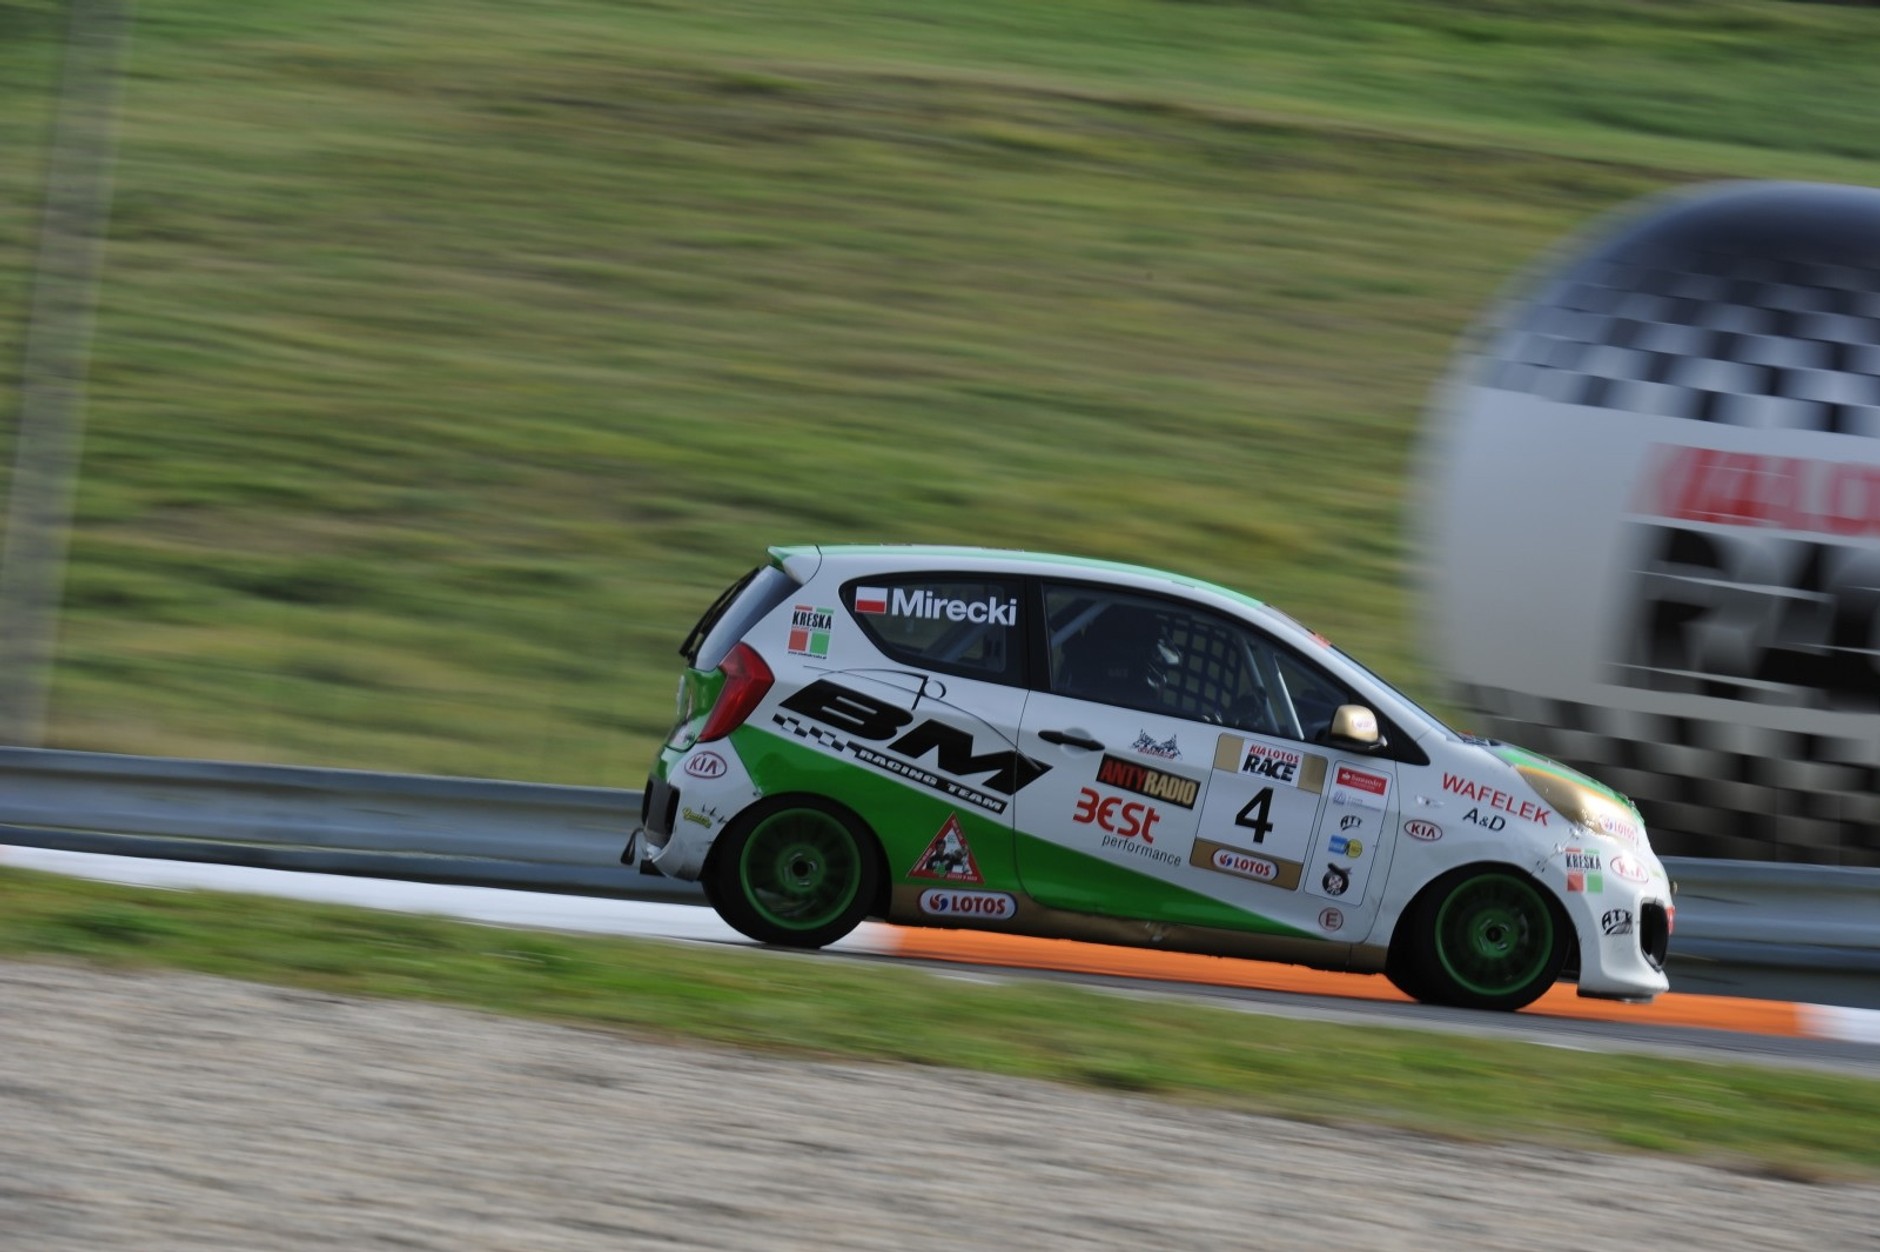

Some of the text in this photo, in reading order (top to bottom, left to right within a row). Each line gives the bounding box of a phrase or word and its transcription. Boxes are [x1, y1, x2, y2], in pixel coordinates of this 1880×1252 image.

[891, 587, 1017, 626] Mirecki
[792, 610, 832, 630] KRESKA
[778, 678, 1054, 796] BM
[688, 756, 719, 775] KIA
[1250, 744, 1300, 764] KIA LOTOS
[1242, 754, 1298, 782] RACE
[858, 748, 1004, 812] RACING TEAM
[1442, 772, 1551, 826] WAFELEK
[1235, 786, 1274, 844] 4
[1462, 807, 1506, 832] A&D
[1411, 823, 1436, 839] KIA
[1102, 834, 1182, 867] performance
[1566, 853, 1602, 870] KRESKA
[1234, 856, 1271, 877] LOTOS
[951, 895, 1006, 915] LOTOS
[1326, 912, 1339, 927] E
